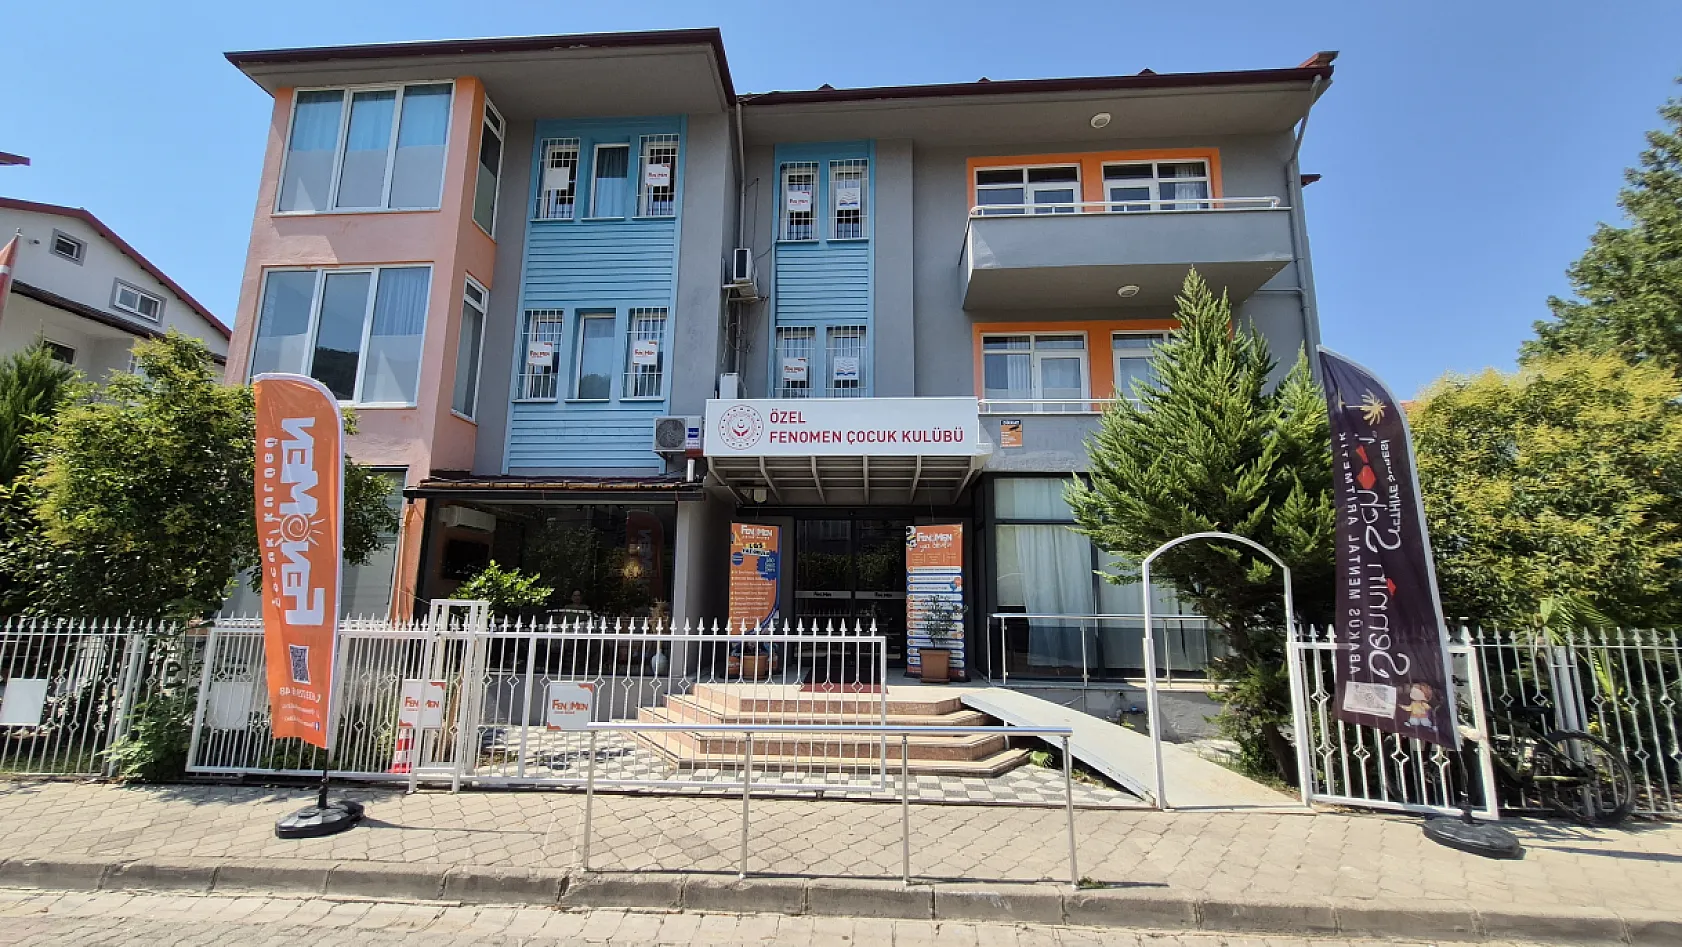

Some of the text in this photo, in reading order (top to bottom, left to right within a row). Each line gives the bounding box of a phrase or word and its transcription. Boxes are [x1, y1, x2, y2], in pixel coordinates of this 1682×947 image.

[769, 408, 806, 424] ÖZEL
[769, 426, 964, 445] FENOMEN ÇOCUK KULÜBÜ
[405, 696, 440, 709] FENMEN
